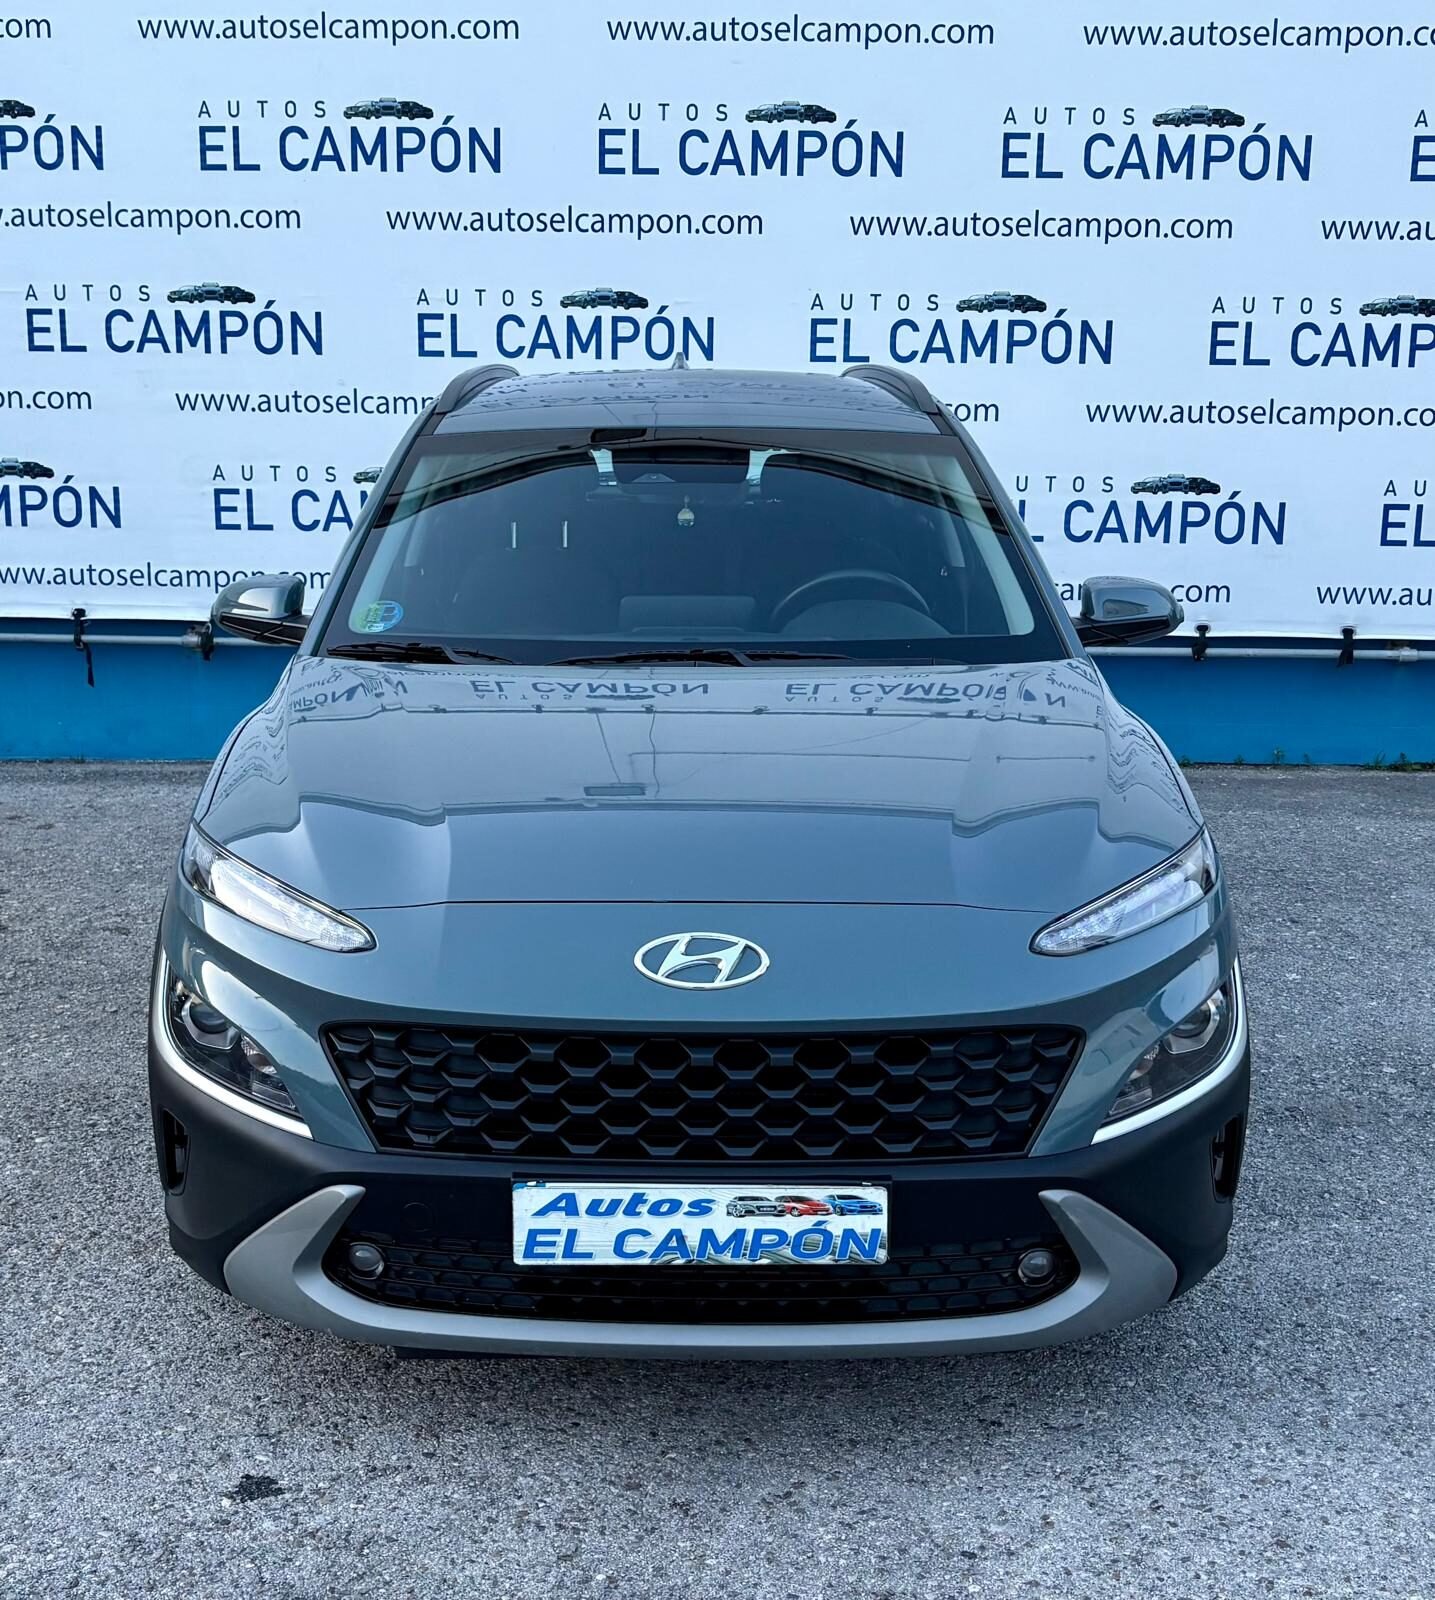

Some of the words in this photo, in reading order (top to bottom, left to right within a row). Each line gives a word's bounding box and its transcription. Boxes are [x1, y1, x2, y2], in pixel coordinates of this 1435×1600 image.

[137, 10, 520, 47] www.autoselcampon.com
[606, 13, 994, 51] www.autoselcampon.com
[197, 99, 327, 119] AUTOS
[597, 102, 728, 122] AUTOS
[1002, 106, 1135, 126] AUTOS
[198, 125, 261, 172] EL
[278, 115, 502, 174] CAMPÓN
[598, 127, 660, 176] EL
[678, 118, 905, 178] CAMPÓN
[1000, 131, 1064, 179] EL
[1083, 122, 1313, 182] CAMPÓN
[0, 200, 301, 236] .autoselcampon.com
[385, 204, 763, 241] www.autoselcampon.com
[849, 208, 1233, 245] www.autoselcampon.com
[24, 283, 151, 303] AUTOS
[416, 287, 543, 308] AUTOS
[810, 292, 939, 312] AUTOS
[1211, 295, 1342, 316] AUTOS
[25, 307, 88, 353] EL
[104, 299, 324, 356] CAMPÓN
[416, 312, 478, 359] EL
[495, 304, 715, 362] CAMPÓN
[809, 317, 871, 364] EL
[889, 307, 1114, 365] CAMPÓN
[1208, 320, 1271, 367] EL
[212, 463, 337, 483] AUTOS
[213, 487, 275, 532] EL
[1063, 490, 1287, 546] CAMPÓN
[1379, 503, 1435, 548] EL
[530, 1191, 718, 1217] Autos
[521, 1227, 598, 1260] EL
[611, 1219, 882, 1260] CAMPÓN
